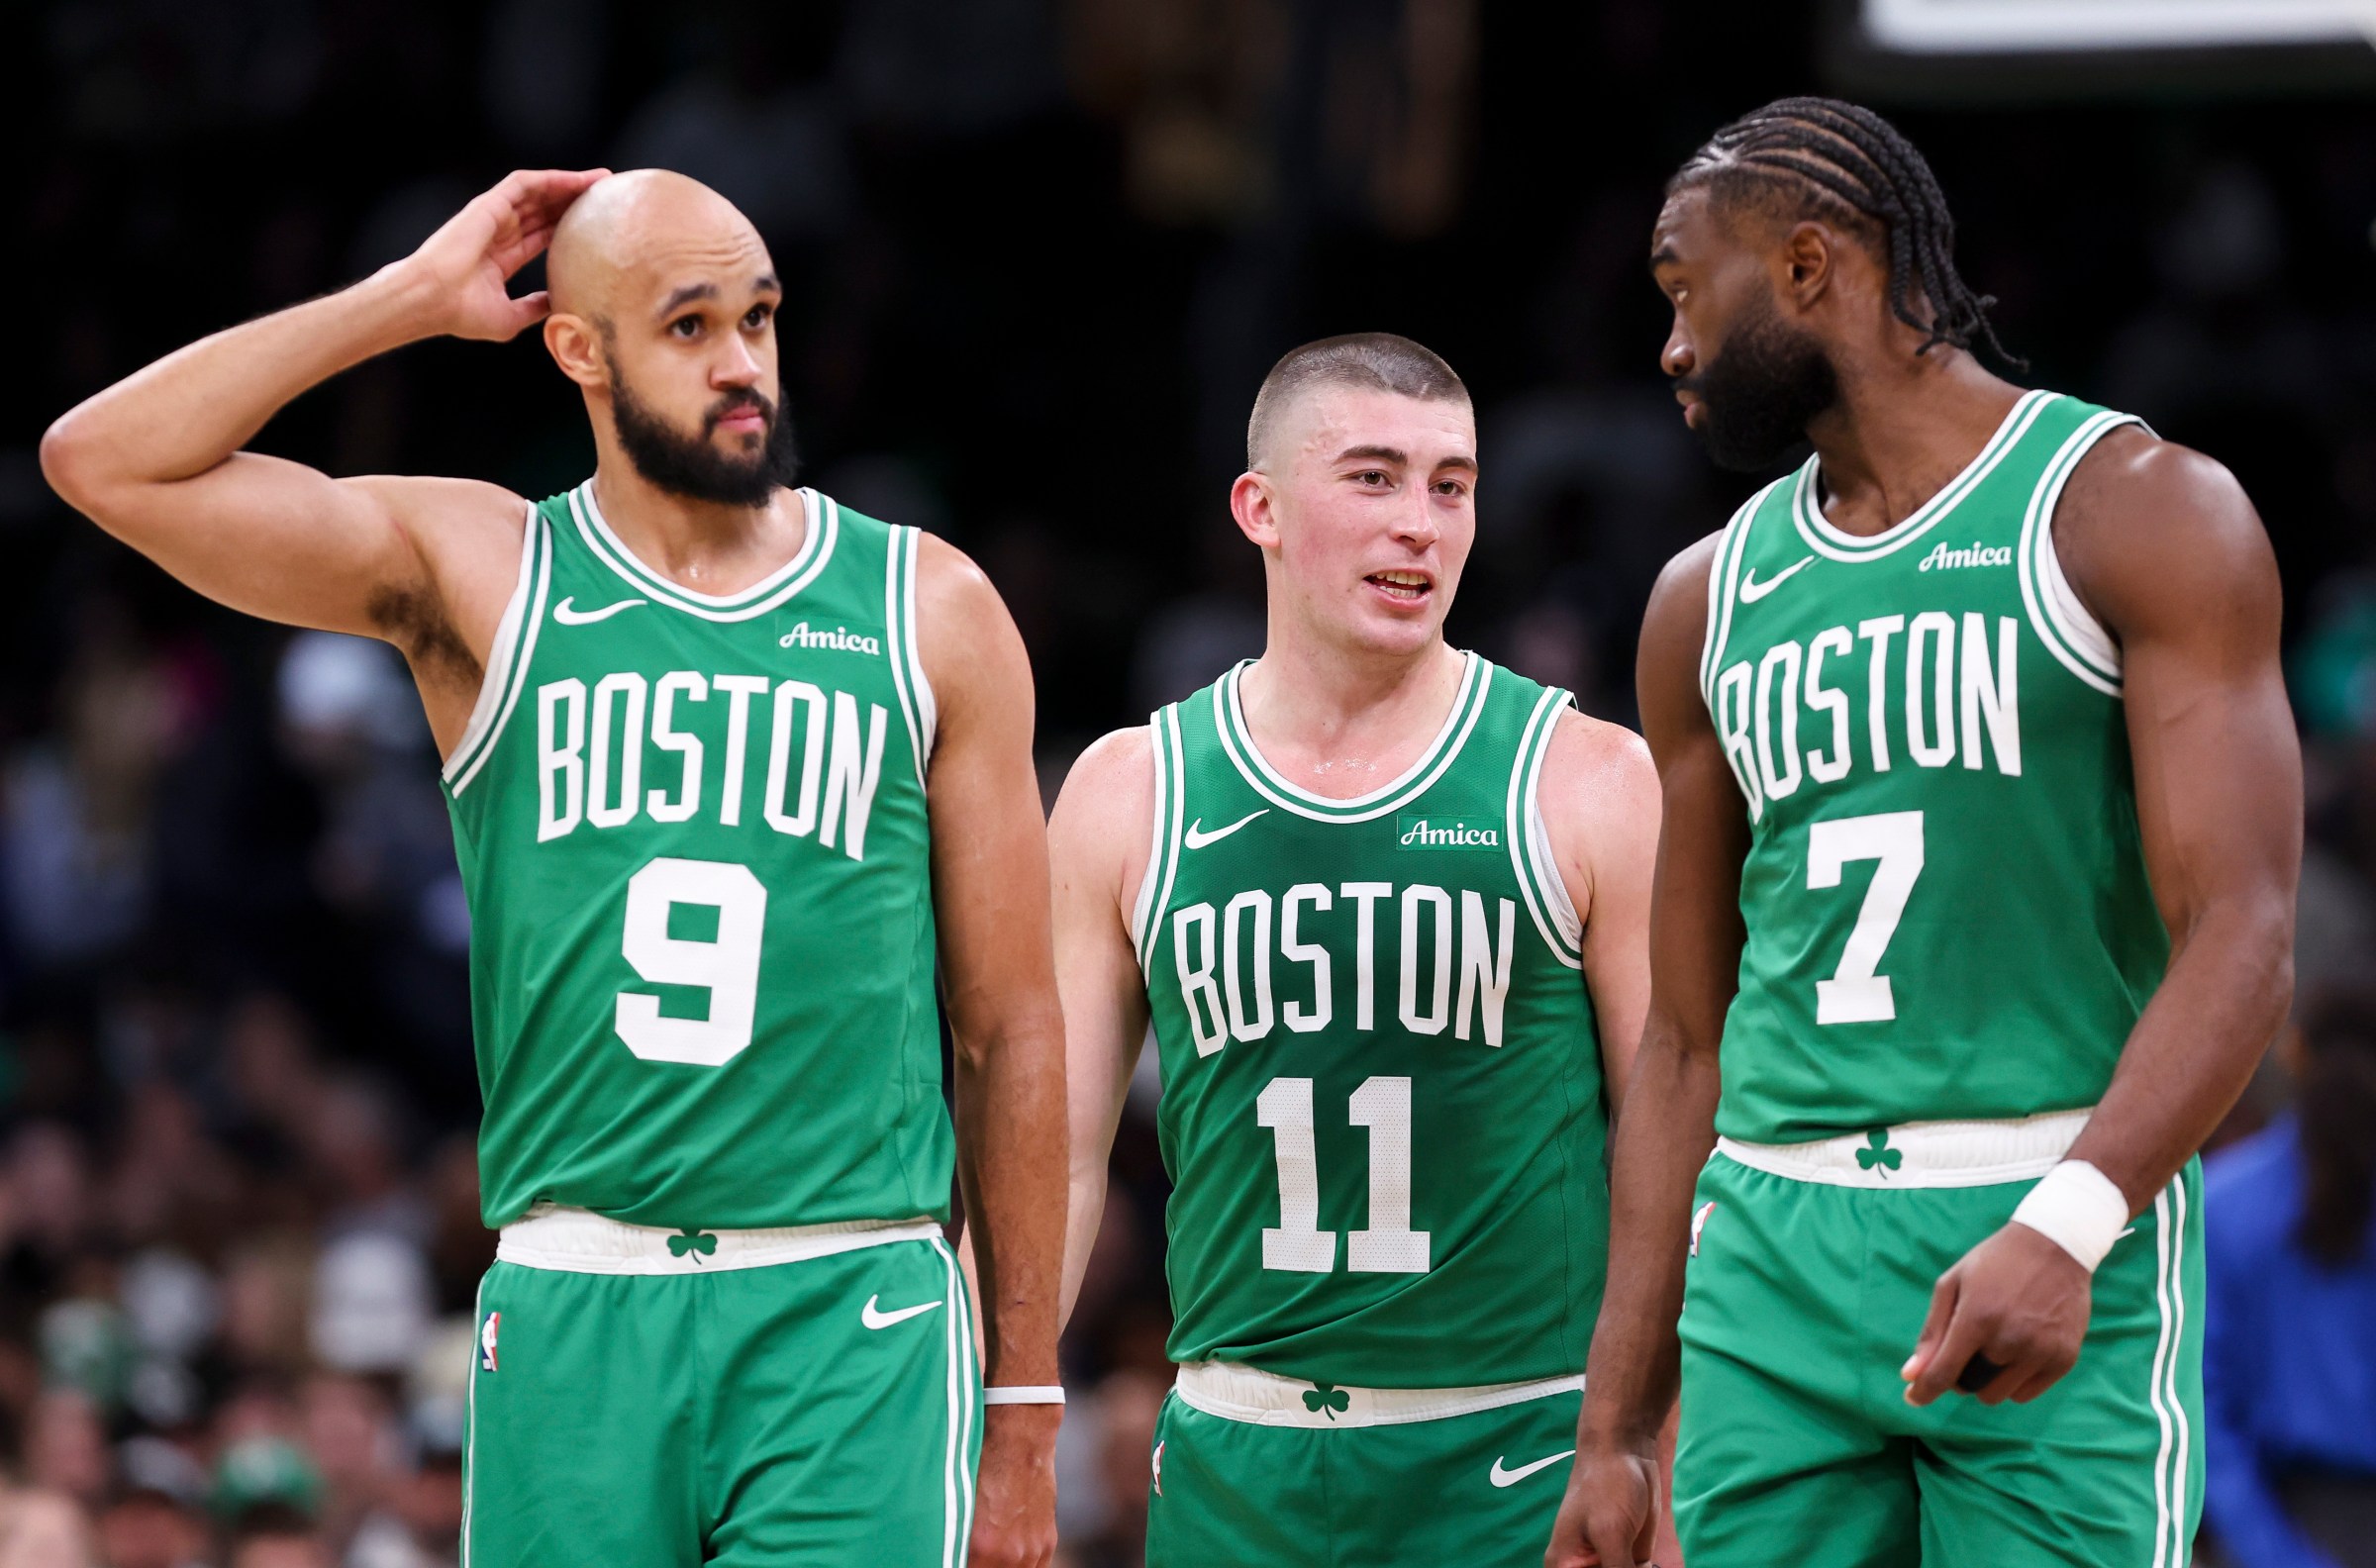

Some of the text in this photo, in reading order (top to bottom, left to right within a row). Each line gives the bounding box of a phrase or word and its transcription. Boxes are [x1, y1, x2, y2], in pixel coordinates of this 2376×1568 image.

[778, 621, 881, 656] Amica
[1918, 541, 2014, 572] Amica
[537, 670, 889, 863] BOSTON
[1717, 610, 2022, 826] BOSTON
[1400, 819, 1499, 847] Amica
[1805, 811, 1925, 1025] 7
[615, 857, 768, 1067] 9
[1173, 881, 1516, 1059] BOSTON
[1256, 1076, 1432, 1274] 11
